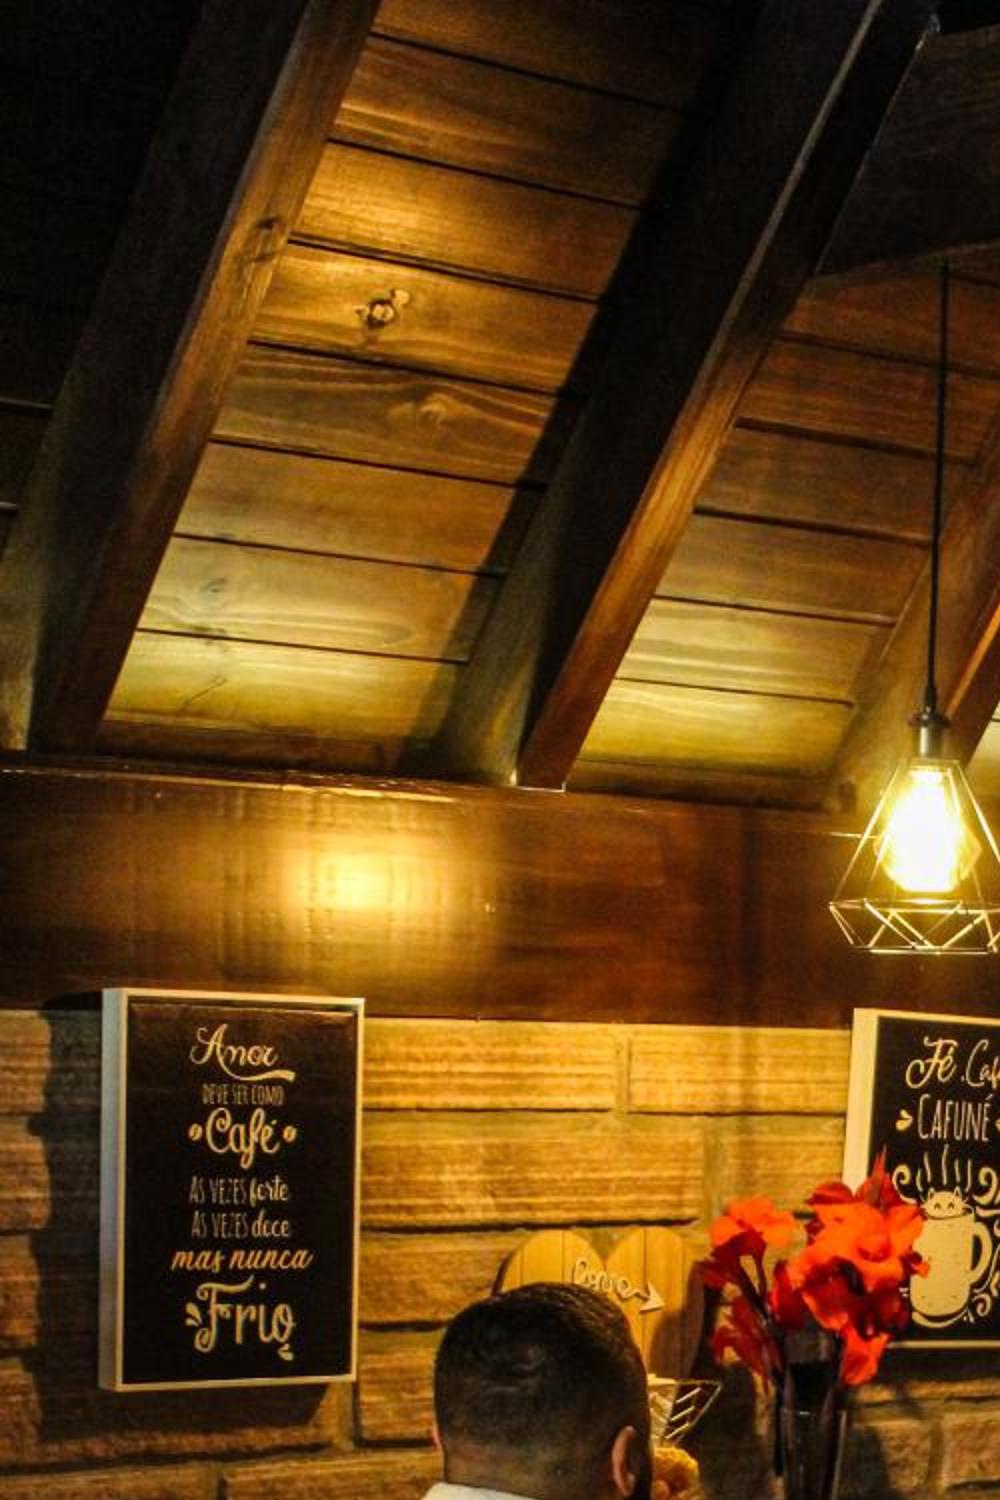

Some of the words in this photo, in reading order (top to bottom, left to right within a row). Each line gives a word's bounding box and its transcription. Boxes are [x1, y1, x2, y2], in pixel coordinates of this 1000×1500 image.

[206, 1108, 280, 1168] Café
[249, 1174, 290, 1208] forte
[251, 1209, 290, 1238] doce
[171, 1250, 224, 1273] mas
[228, 1249, 314, 1270] nunca
[196, 1275, 296, 1352] Frio
